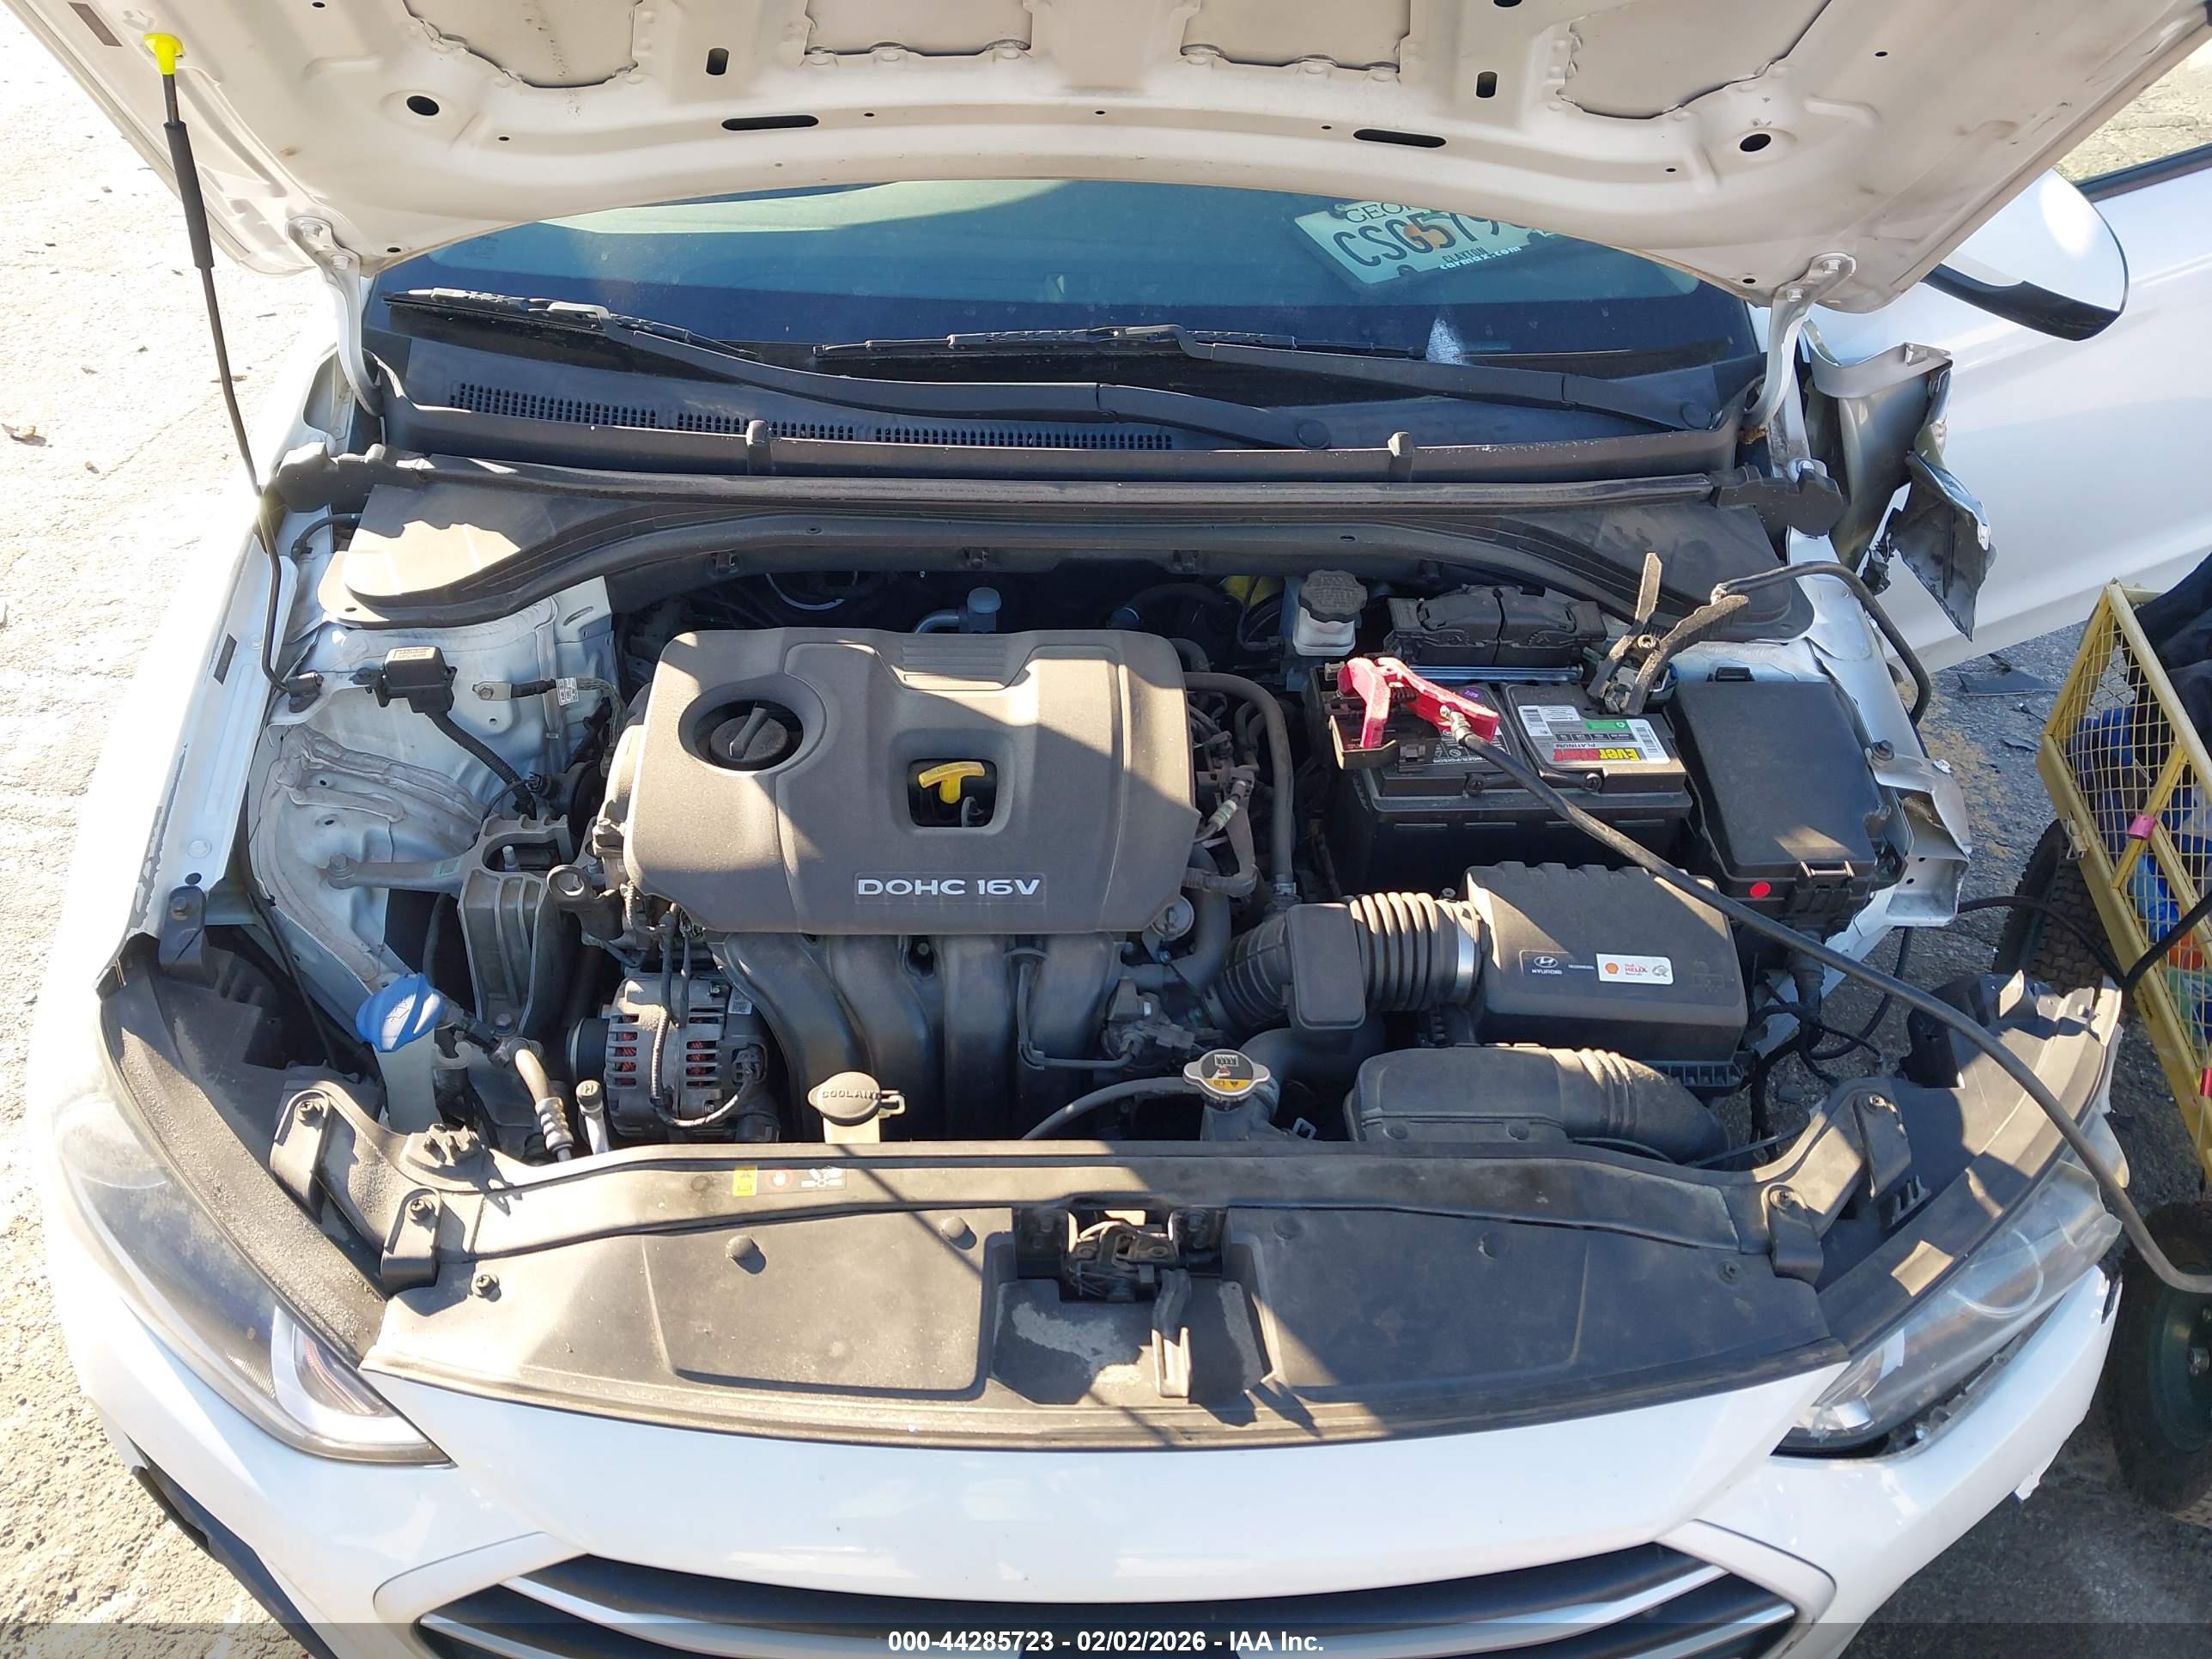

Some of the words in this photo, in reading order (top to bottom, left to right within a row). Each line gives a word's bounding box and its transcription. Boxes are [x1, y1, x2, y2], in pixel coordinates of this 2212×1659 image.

[1440, 246, 1522, 270] carmax.com
[1553, 747, 1641, 762] EverStart
[859, 879, 966, 896] DOHC
[977, 879, 1041, 896] 16V
[822, 1090, 882, 1100] COOLANT
